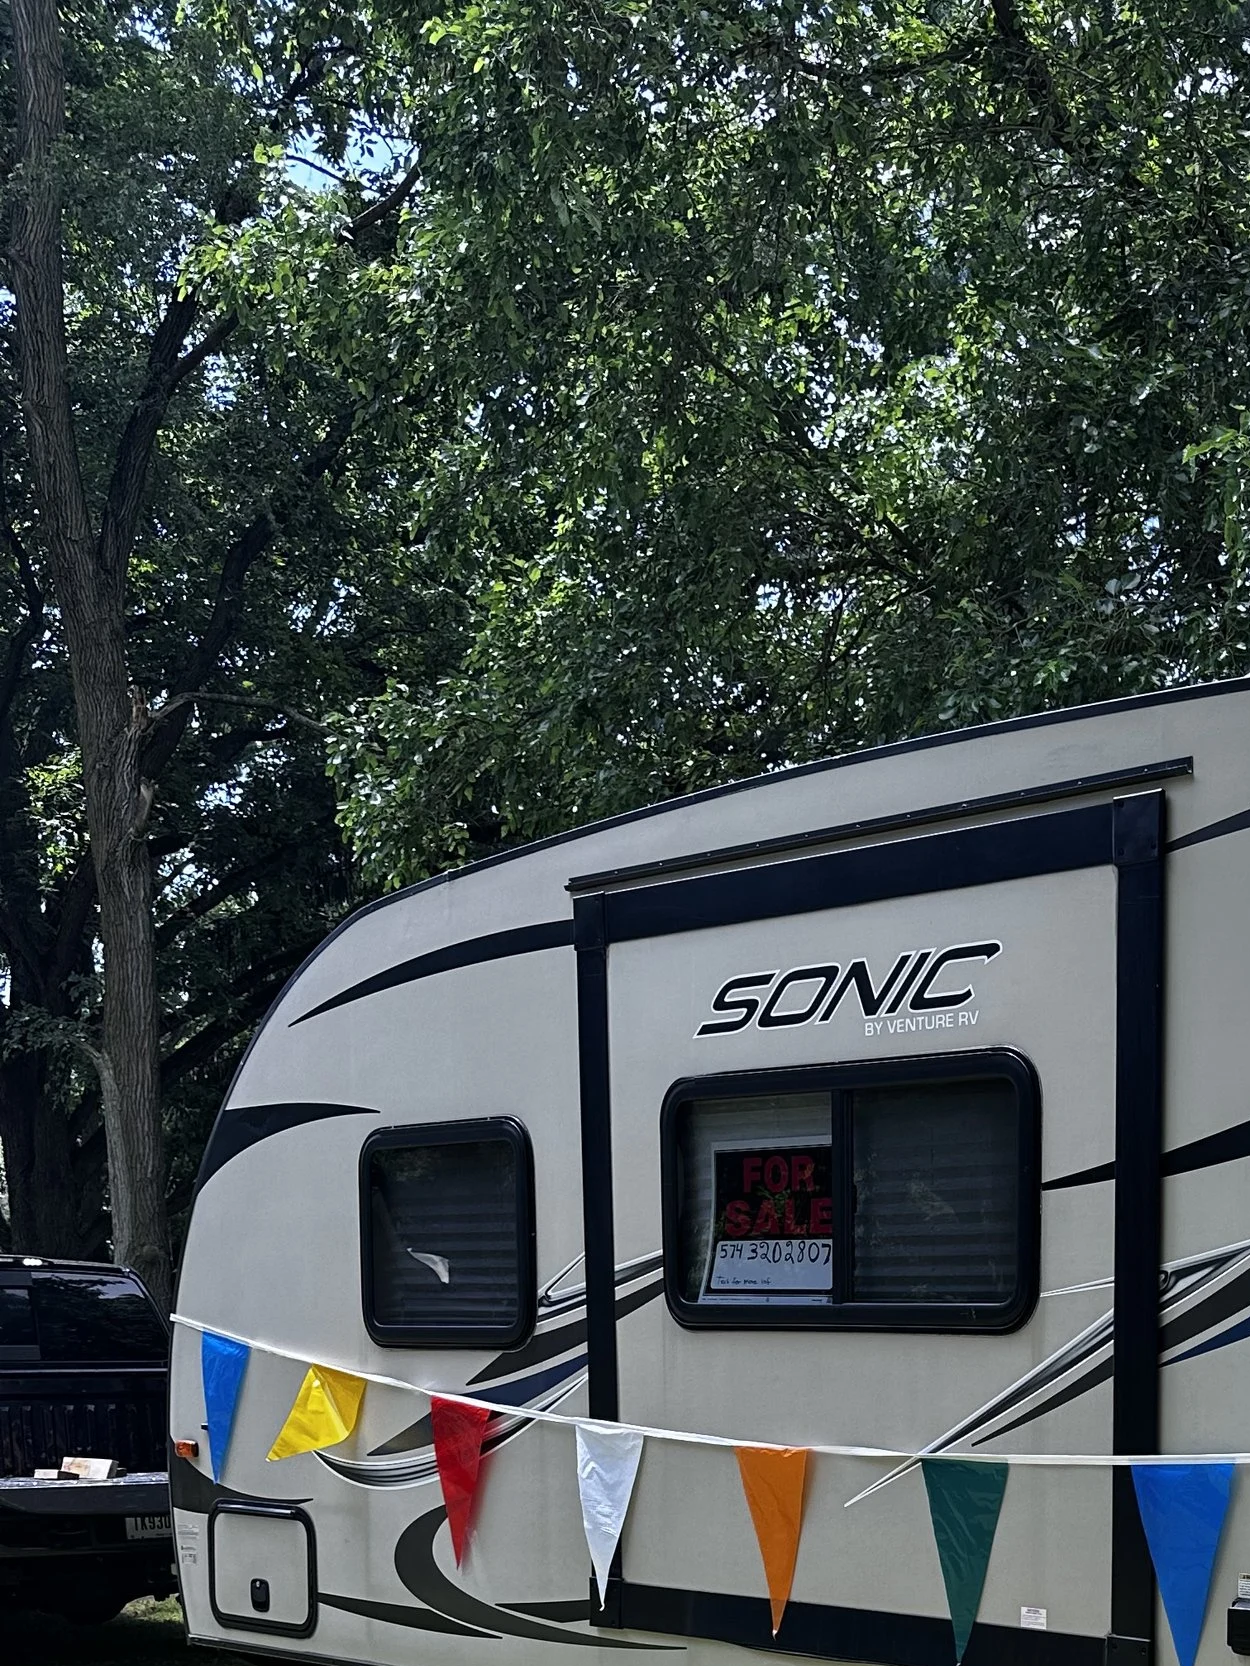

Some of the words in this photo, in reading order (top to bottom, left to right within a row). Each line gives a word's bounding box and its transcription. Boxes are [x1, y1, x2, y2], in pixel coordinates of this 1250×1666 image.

[693, 939, 1003, 1039] SONIC
[864, 1020, 882, 1037] BY
[887, 1013, 954, 1034] VENTURE
[958, 1010, 980, 1026] RV
[742, 1155, 816, 1193] FOR
[724, 1197, 832, 1237] SALE
